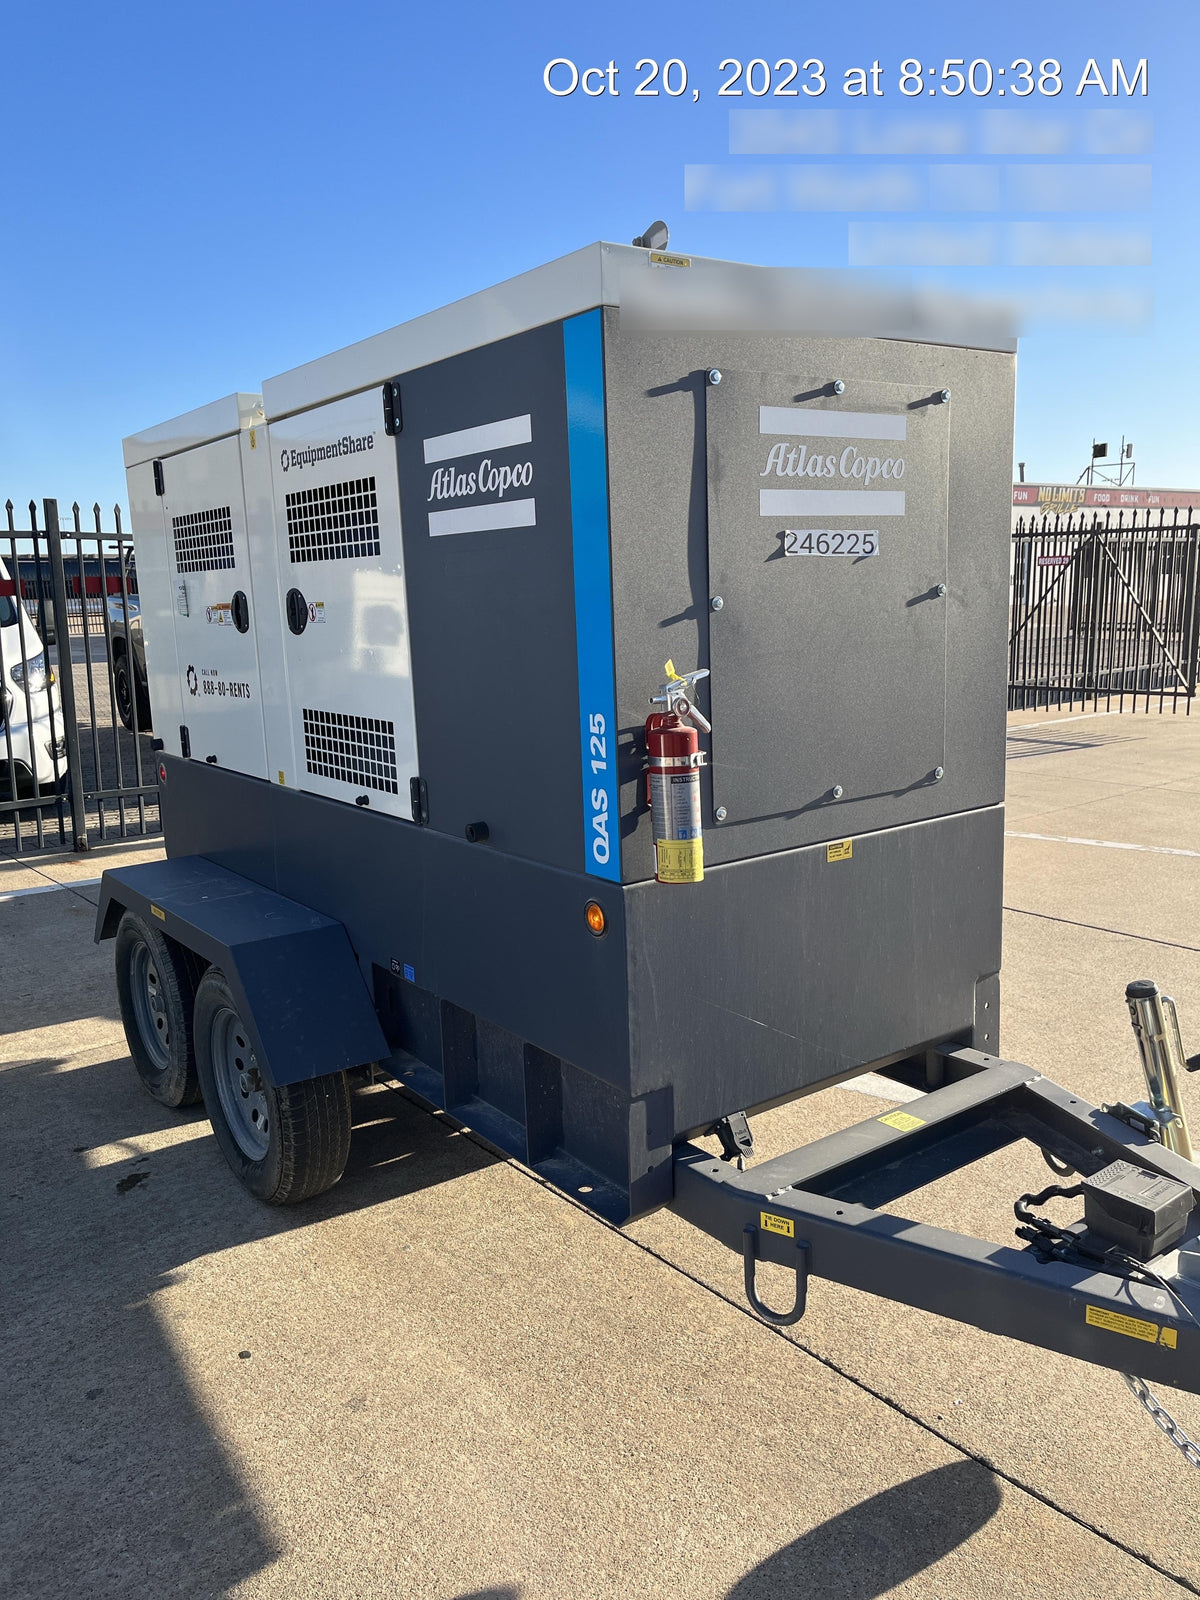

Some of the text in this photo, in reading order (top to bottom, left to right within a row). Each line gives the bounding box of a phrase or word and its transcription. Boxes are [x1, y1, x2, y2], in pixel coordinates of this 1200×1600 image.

[291, 435, 374, 469] EquipmentShare
[760, 442, 906, 485] Atlas Copco
[427, 459, 533, 501] Atlas Copco
[1013, 491, 1028, 501] FUN
[1093, 493, 1160, 504] FOOD DRINK FUN
[785, 532, 875, 555] 246225
[202, 680, 251, 699] 888-80-RENTS
[589, 713, 610, 865] QAS 125
[769, 1222, 784, 1230] HERE
[773, 1217, 790, 1225] DOWN
